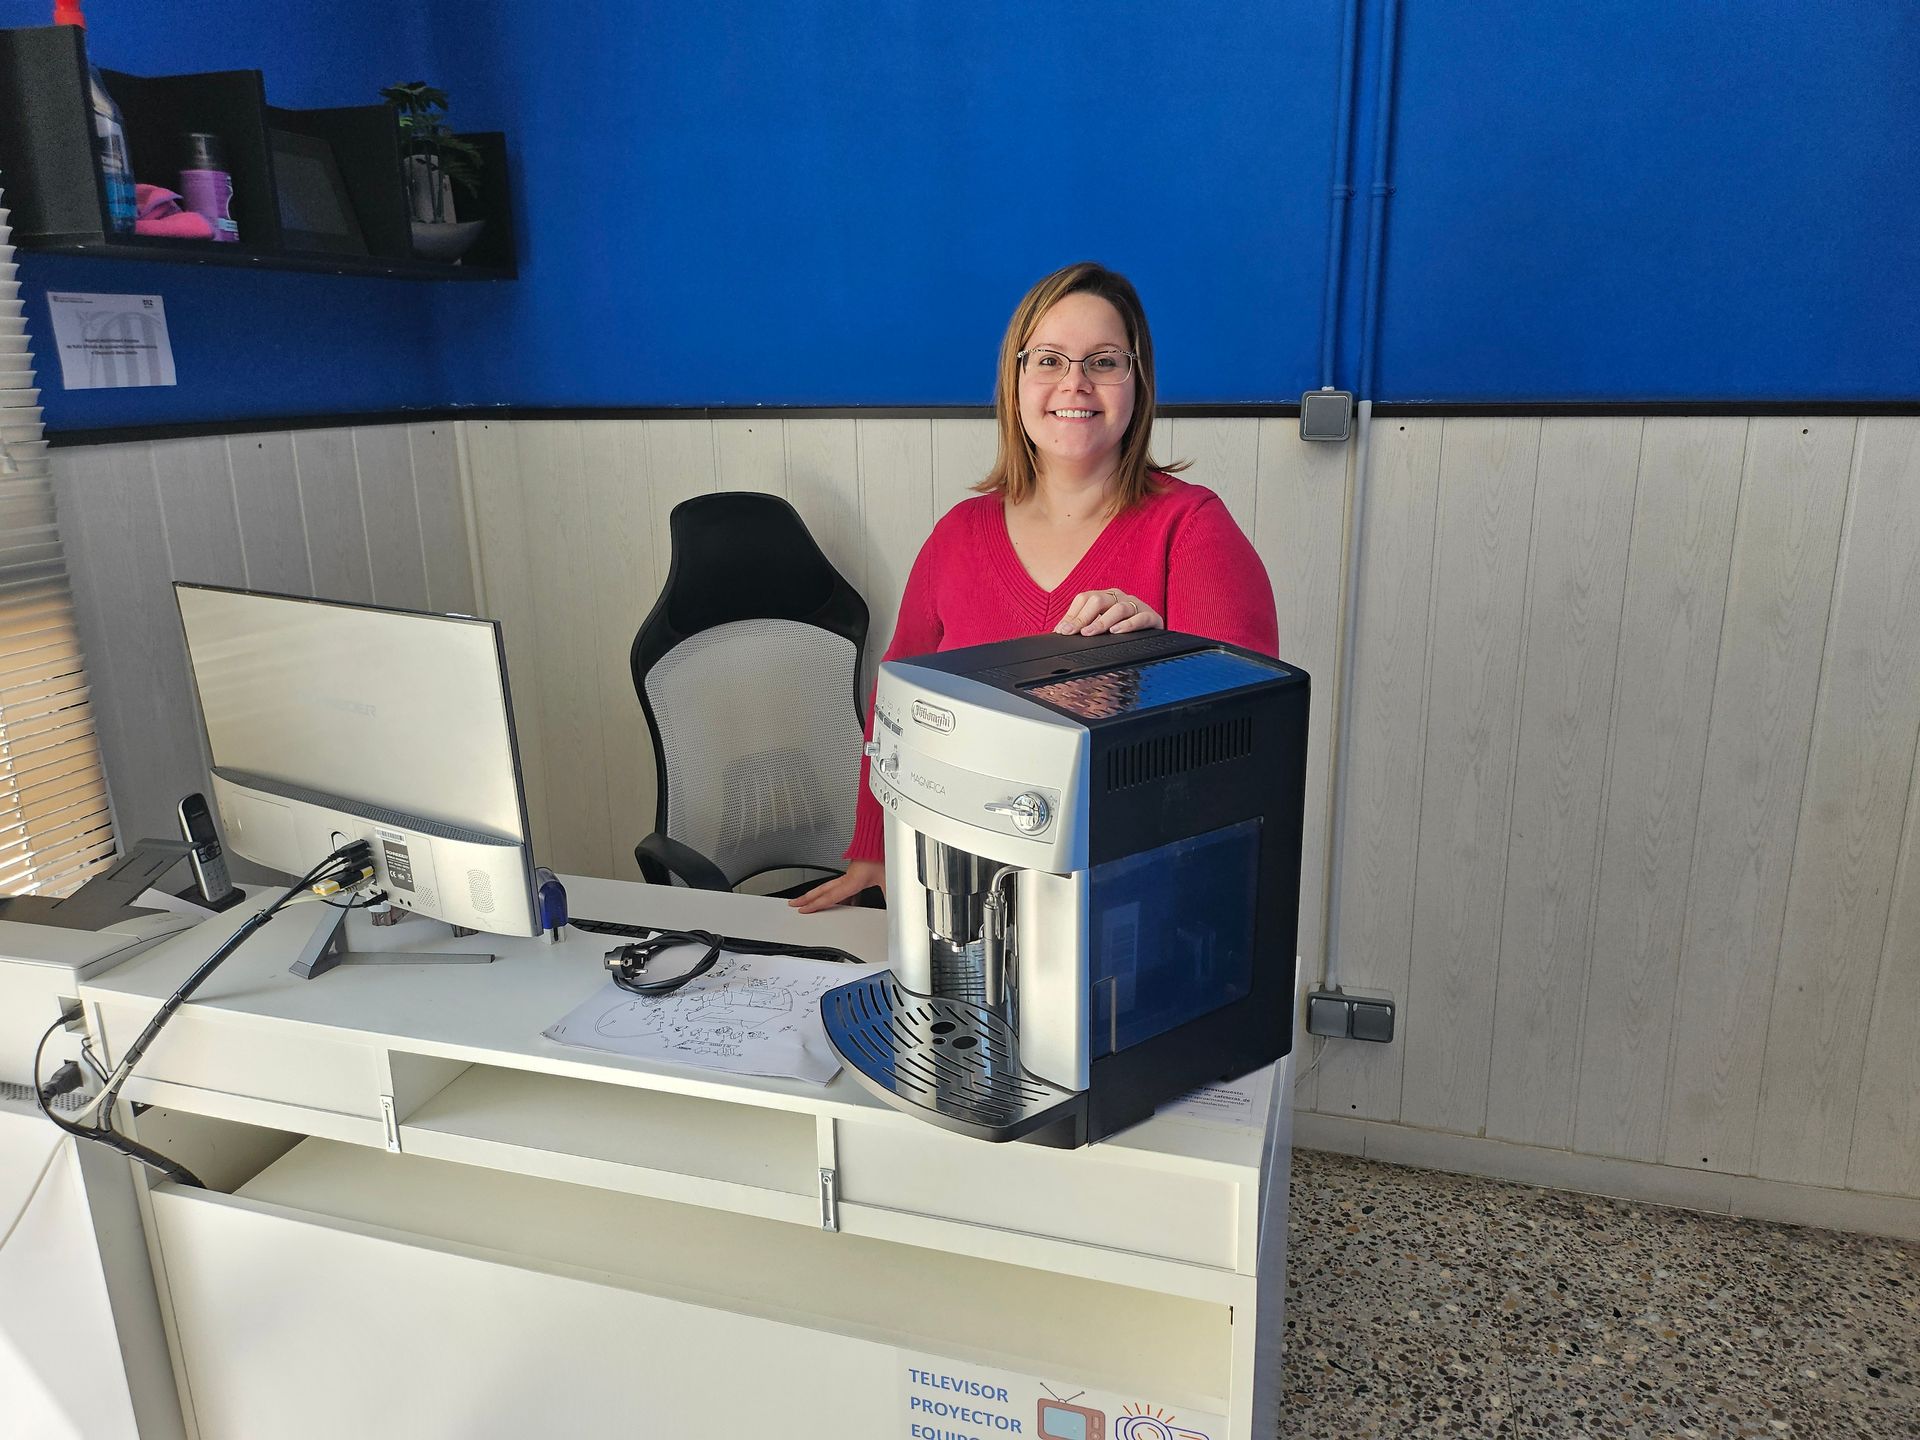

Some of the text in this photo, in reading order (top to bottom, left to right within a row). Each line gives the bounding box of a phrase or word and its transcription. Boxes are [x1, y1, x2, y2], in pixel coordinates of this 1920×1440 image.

[910, 772, 947, 795] MAGNIFICA
[908, 1368, 1009, 1403] TELEVISOR
[910, 1396, 1022, 1434] PROYECTOR
[911, 1423, 981, 1440] EQUI
